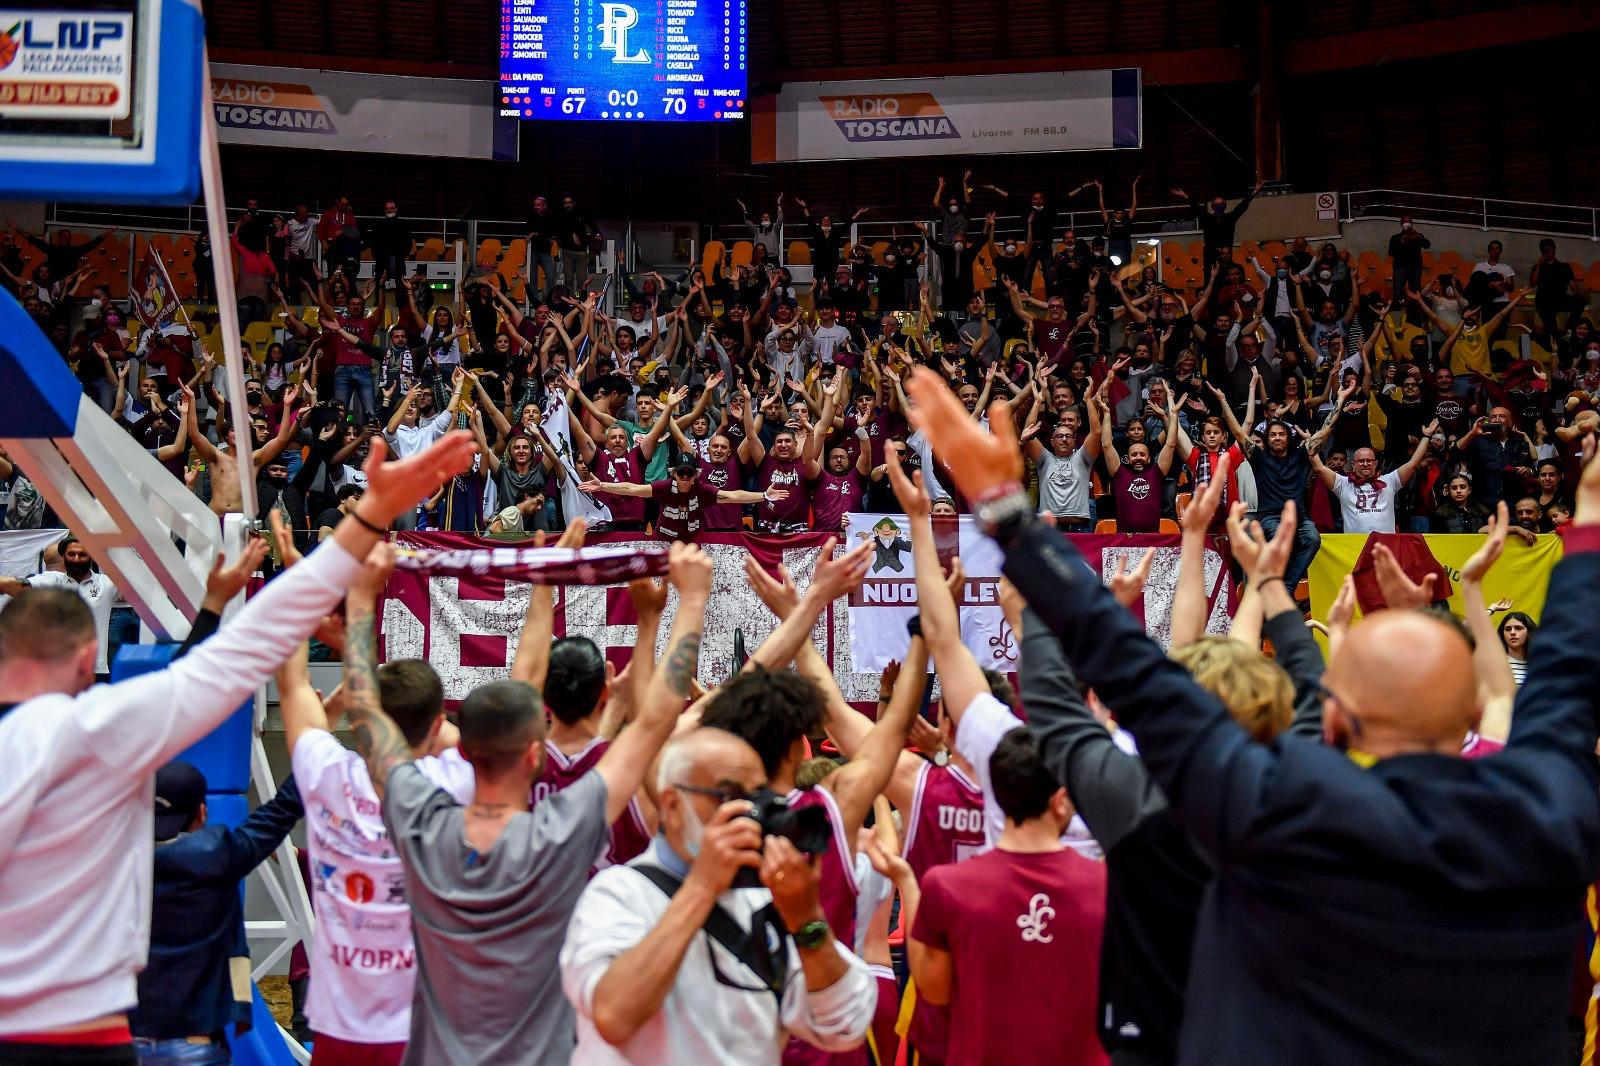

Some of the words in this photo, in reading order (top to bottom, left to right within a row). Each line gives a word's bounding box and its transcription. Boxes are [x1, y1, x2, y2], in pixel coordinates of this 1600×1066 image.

[24, 20, 123, 49] LNP
[23, 54, 51, 62] LEGA
[56, 54, 122, 62] NAZIONALE
[23, 64, 123, 74] PALLACANESTRO
[17, 84, 62, 101] WILD
[64, 84, 113, 102] WEST
[608, 90, 638, 106] 0:0
[544, 96, 552, 107] 5
[562, 98, 586, 114] 67
[662, 98, 686, 114] 70
[698, 98, 705, 108] 5
[834, 97, 899, 116] RADIO
[216, 106, 331, 130] TOSCANA
[845, 119, 951, 138] TOSCANA
[971, 129, 1014, 138] Livorno
[1023, 127, 1040, 136] FM
[1043, 126, 1067, 135] 88.0
[1356, 493, 1379, 509] 87
[863, 583, 918, 603] NUO
[938, 805, 986, 832] UGO
[330, 944, 416, 968] IVORN
